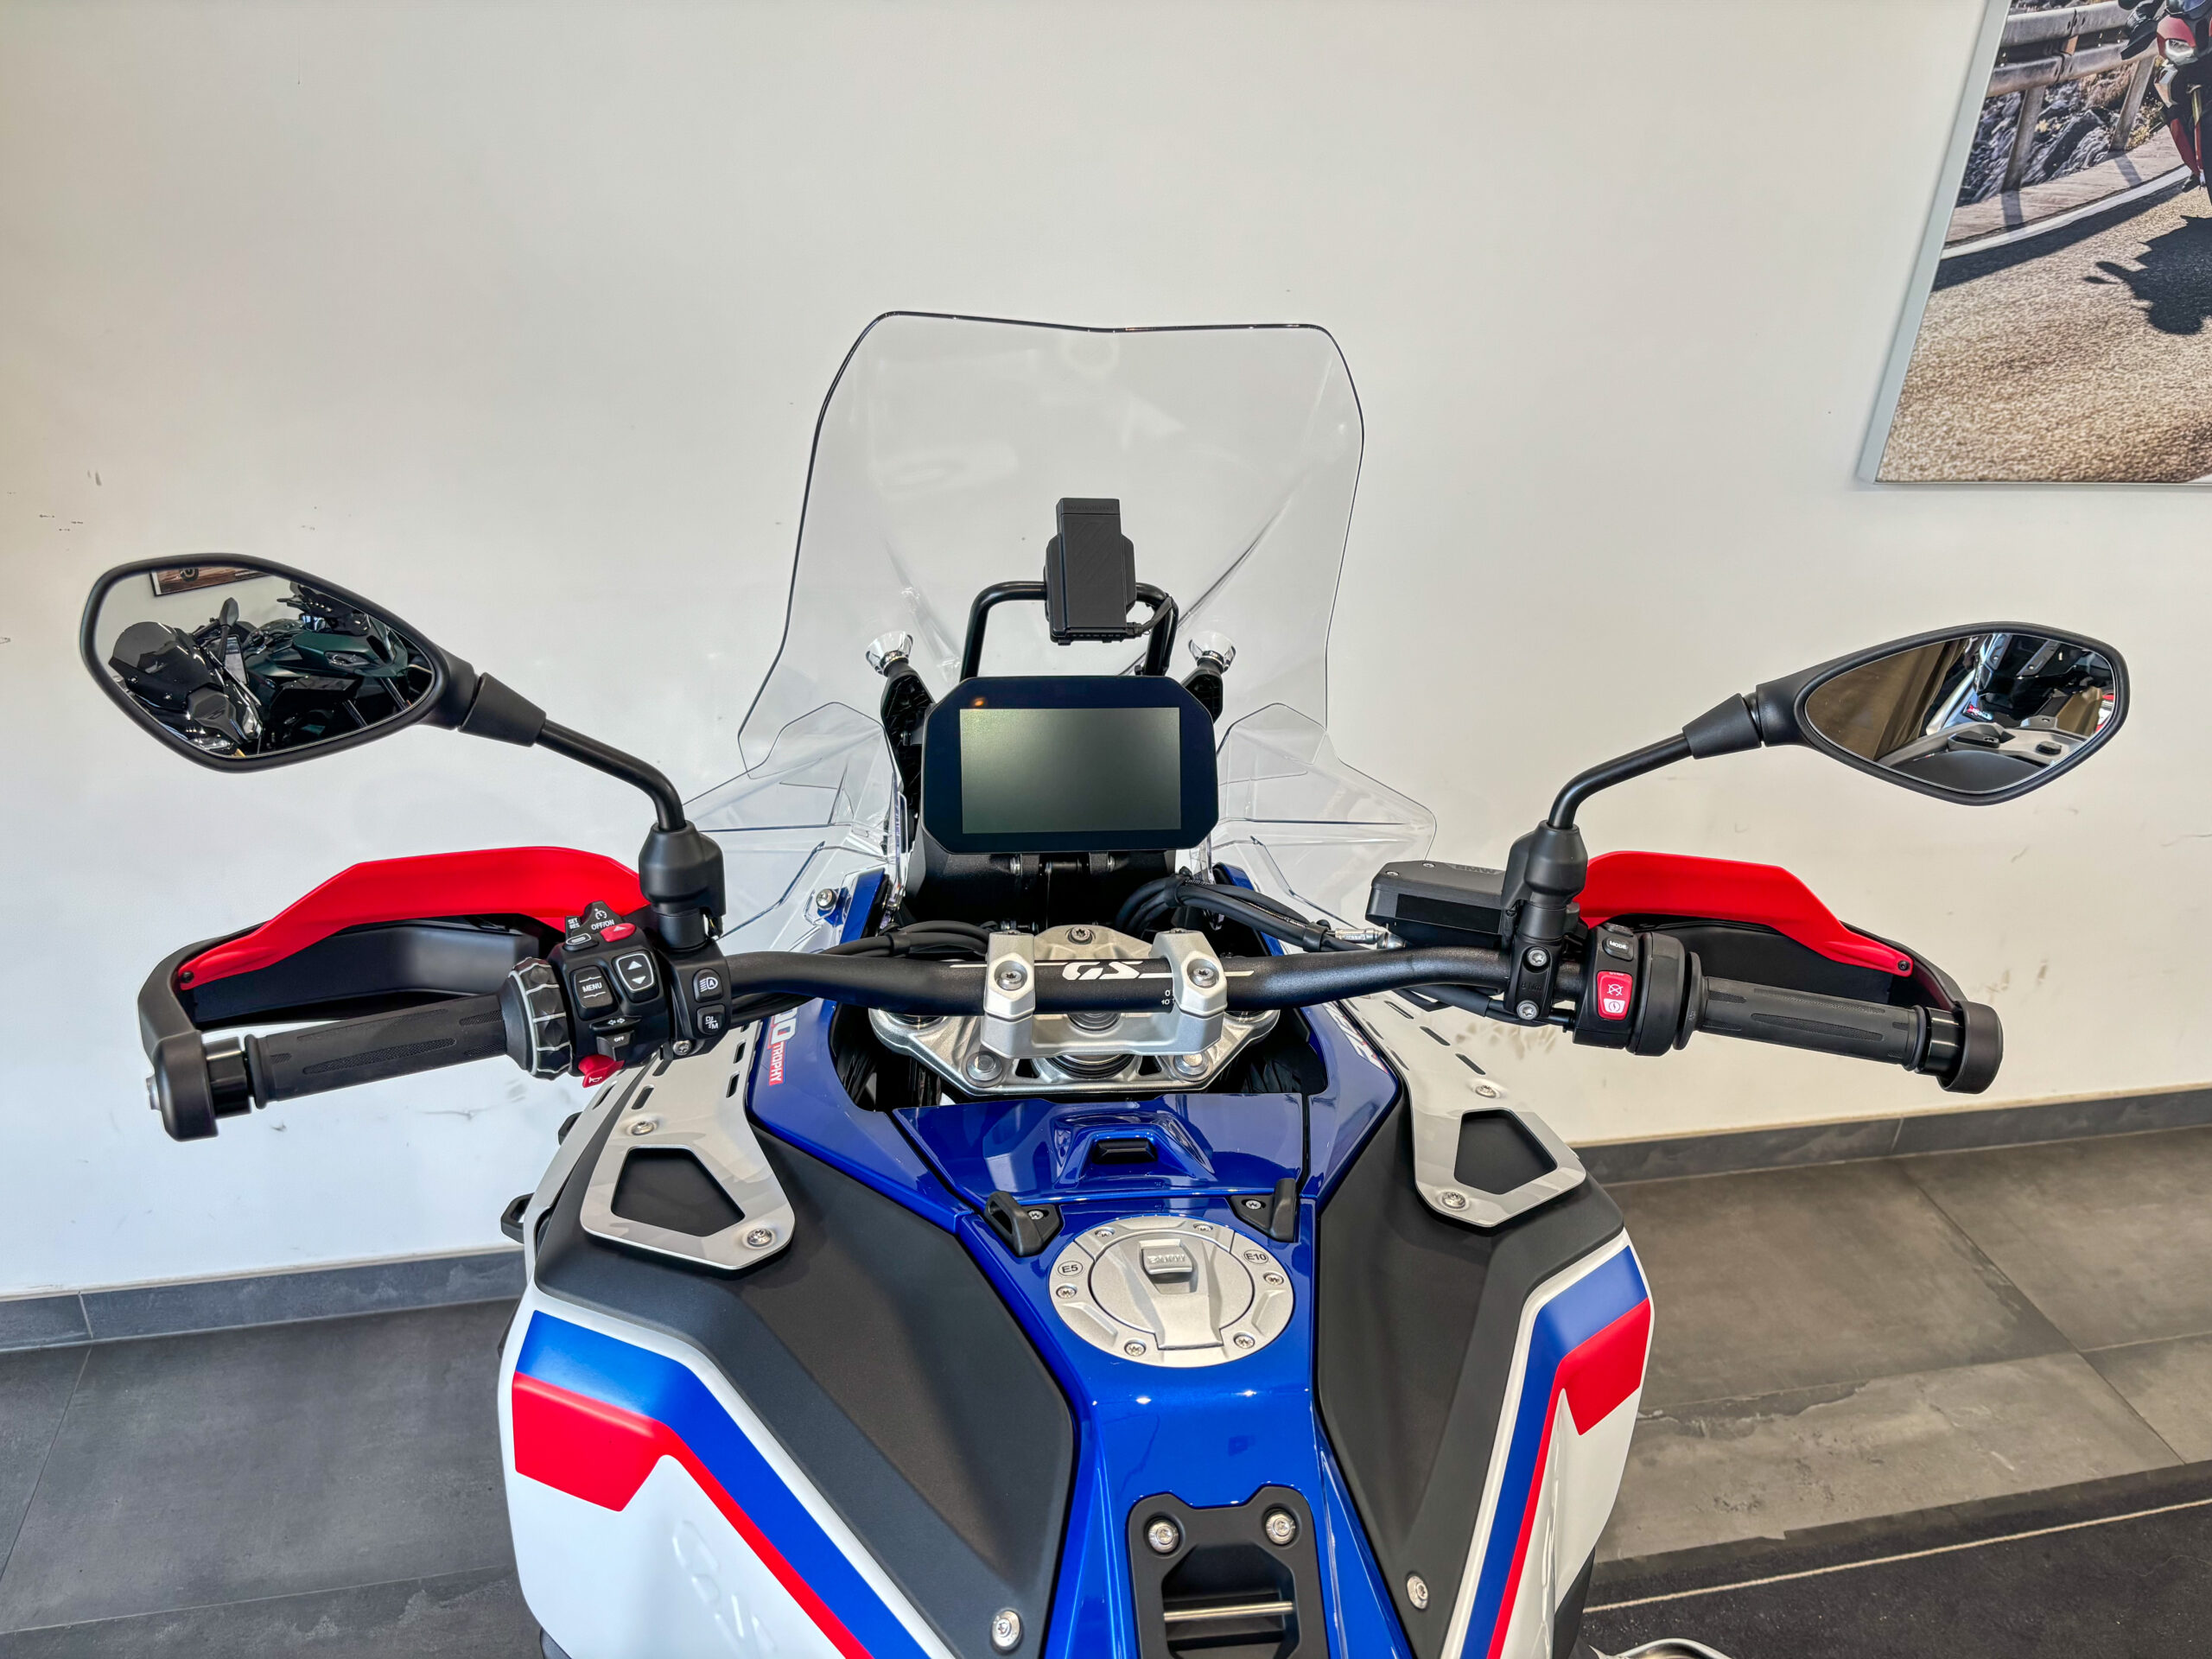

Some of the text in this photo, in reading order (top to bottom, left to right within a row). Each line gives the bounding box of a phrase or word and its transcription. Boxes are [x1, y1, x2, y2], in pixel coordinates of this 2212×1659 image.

[590, 918, 615, 931] OFF/ON
[1609, 940, 1629, 950] MODE
[1061, 960, 1143, 981] GS
[582, 982, 603, 993] MENU
[771, 1041, 785, 1081] TROPHY
[1061, 1264, 1079, 1274] E5
